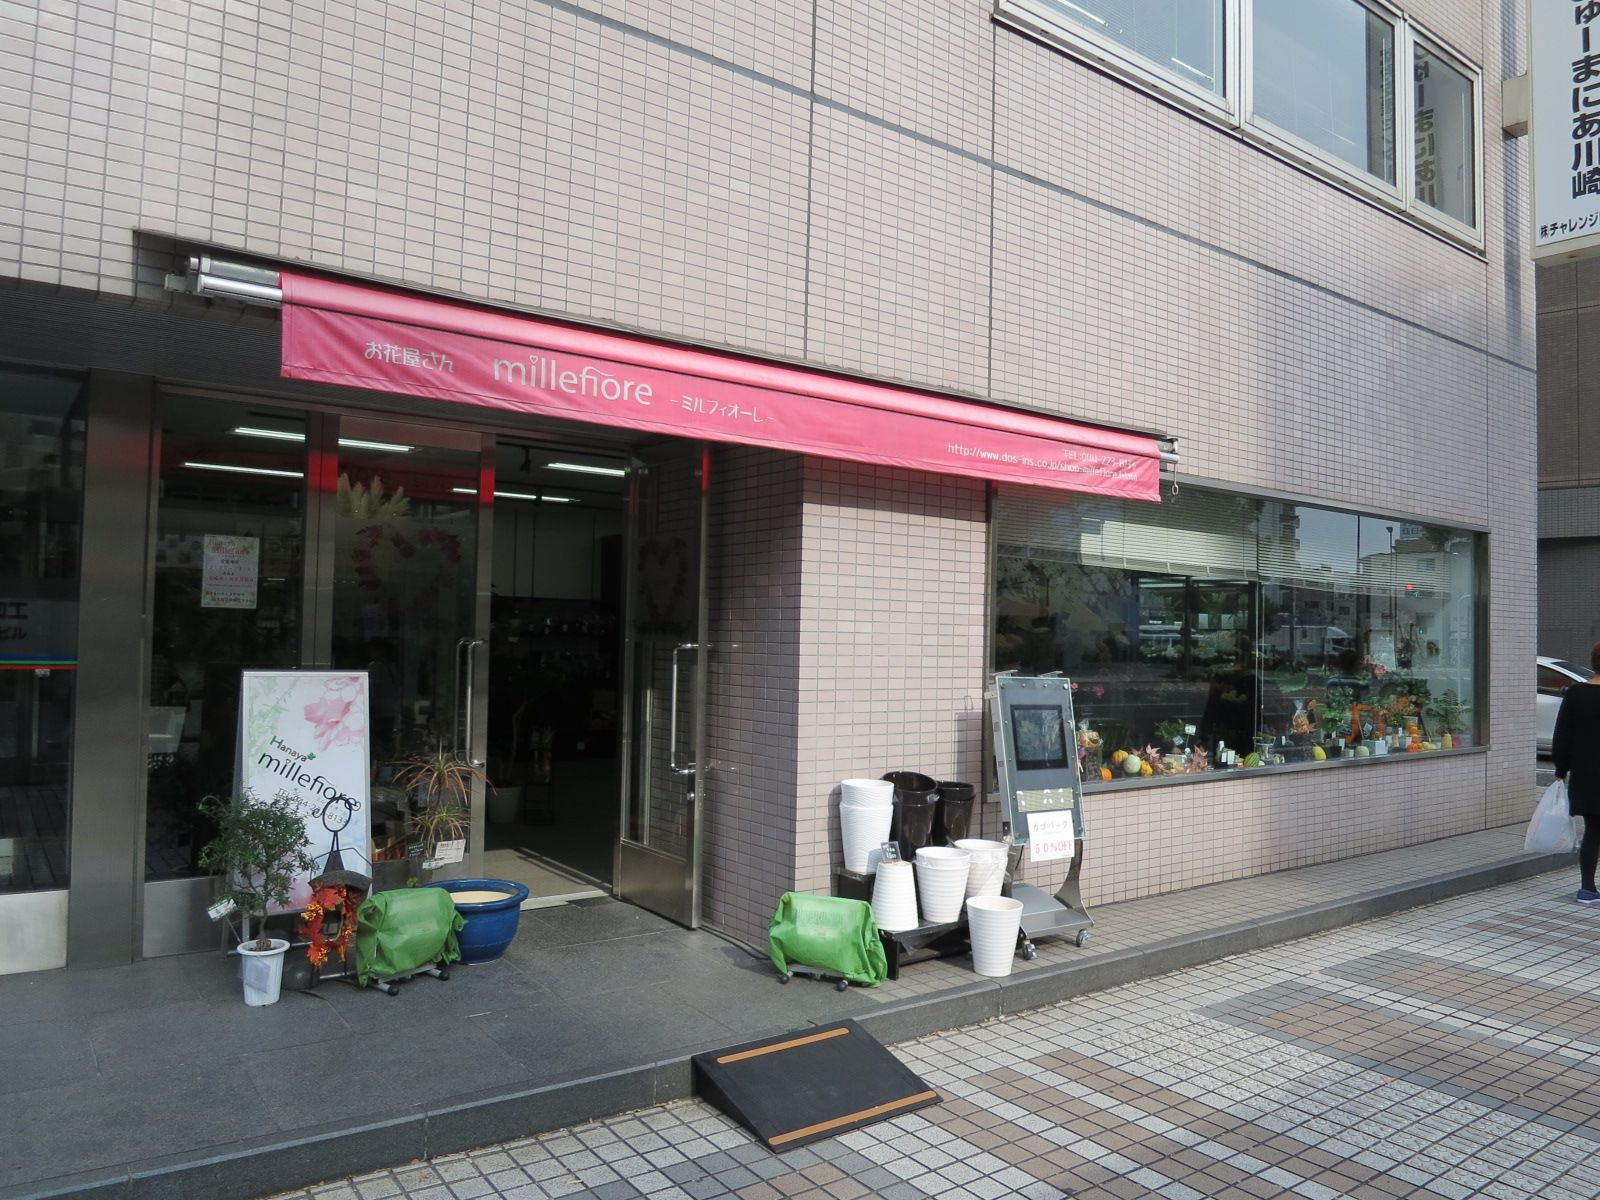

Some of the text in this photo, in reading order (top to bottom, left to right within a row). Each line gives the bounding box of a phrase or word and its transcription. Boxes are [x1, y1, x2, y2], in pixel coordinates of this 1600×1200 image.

[364, 341, 454, 373] お花屋さん
[494, 354, 653, 406] millefiore
[270, 735, 308, 762] Hanaya
[258, 752, 359, 810] millefiore
